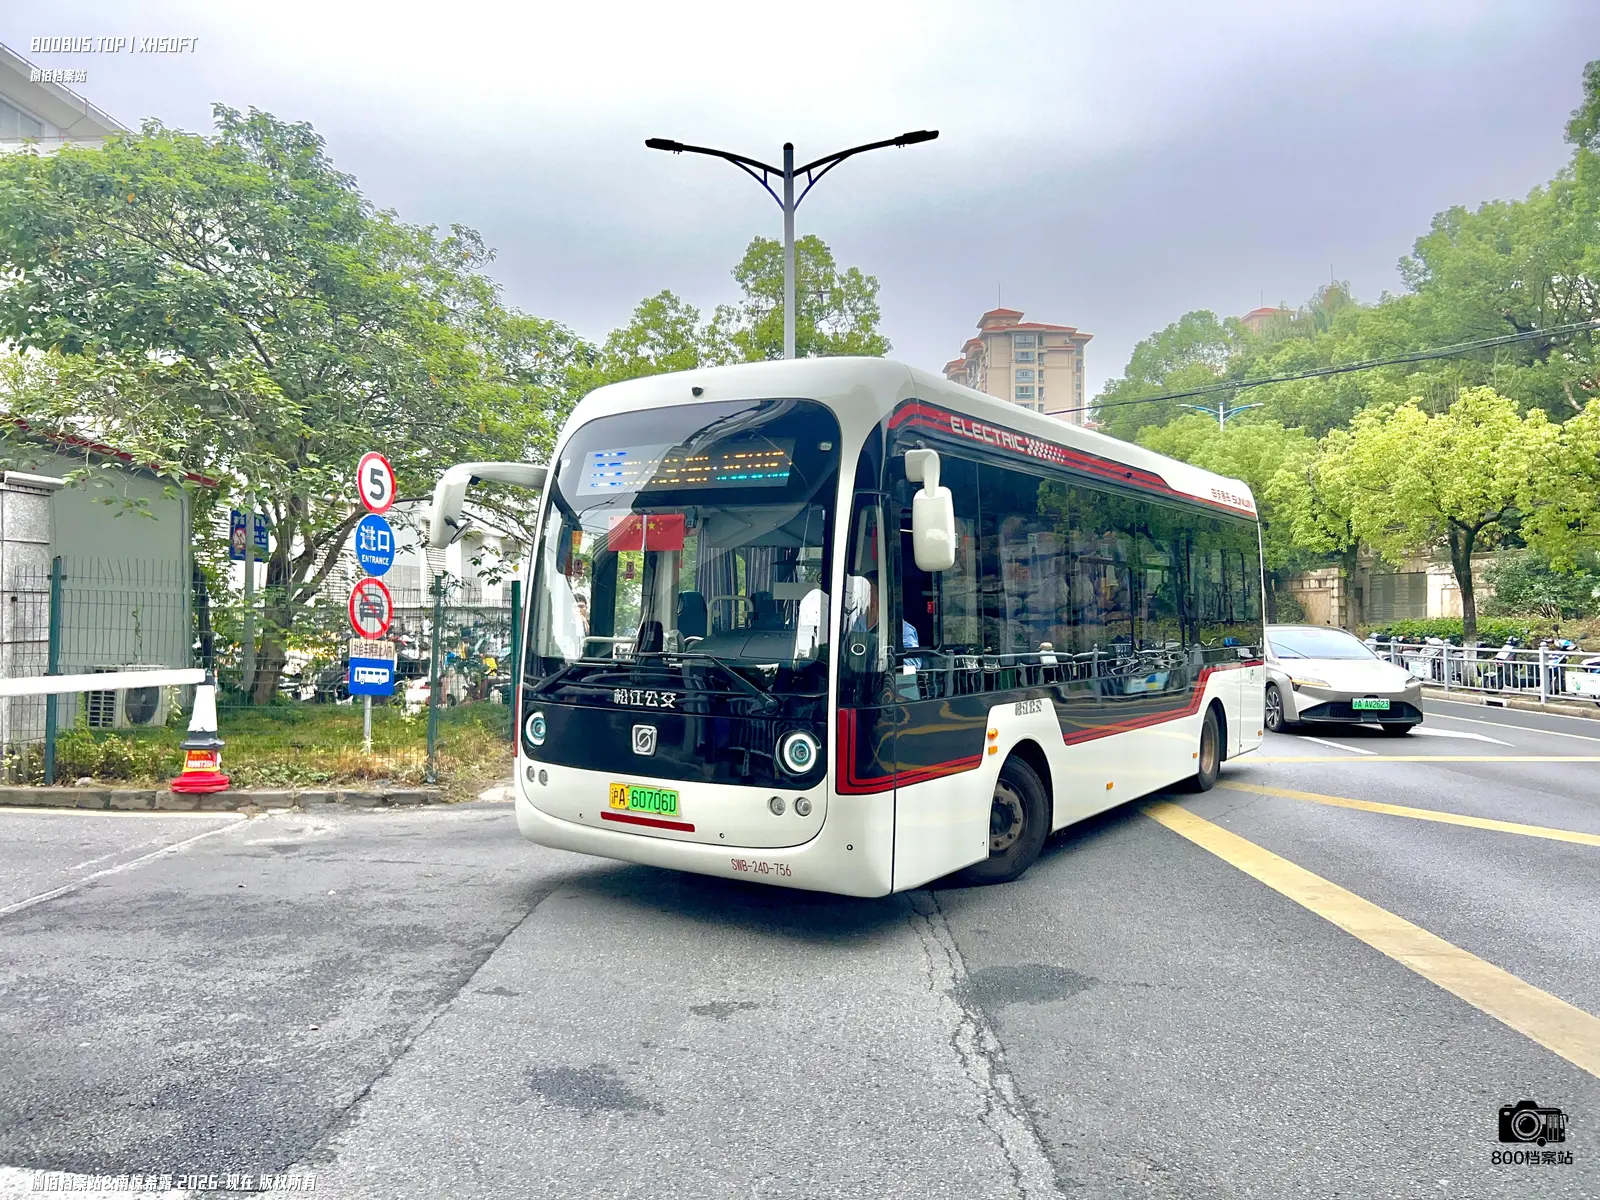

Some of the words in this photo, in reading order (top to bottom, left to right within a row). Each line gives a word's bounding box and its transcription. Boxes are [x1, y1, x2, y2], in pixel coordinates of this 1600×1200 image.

[950, 415, 1025, 452] ELECTRIC
[369, 467, 385, 501] 5
[359, 524, 390, 553] 进口
[361, 553, 390, 566] ENTRANCE
[613, 688, 677, 709] 松江公交
[730, 858, 792, 877] SWB-24D-756
